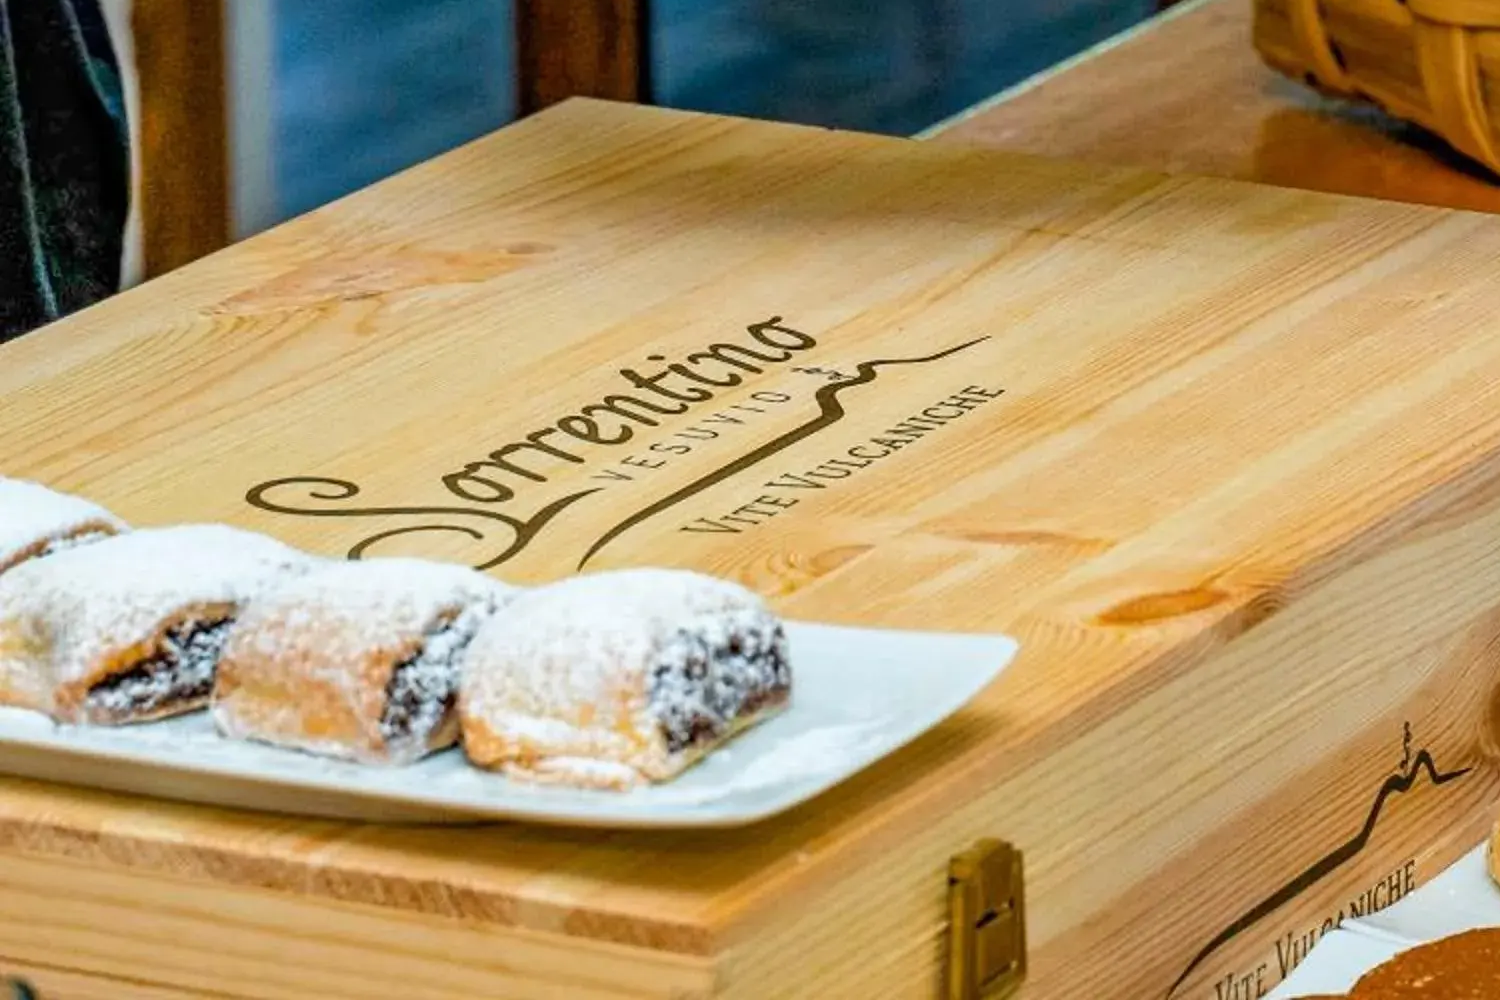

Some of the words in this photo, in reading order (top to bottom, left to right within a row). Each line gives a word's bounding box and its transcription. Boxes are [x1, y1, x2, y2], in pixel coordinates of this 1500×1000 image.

[245, 315, 817, 571] Sorrentino
[591, 391, 791, 481] VESUVIO
[680, 494, 800, 534] VITE
[764, 384, 1006, 489] VULCANICHE
